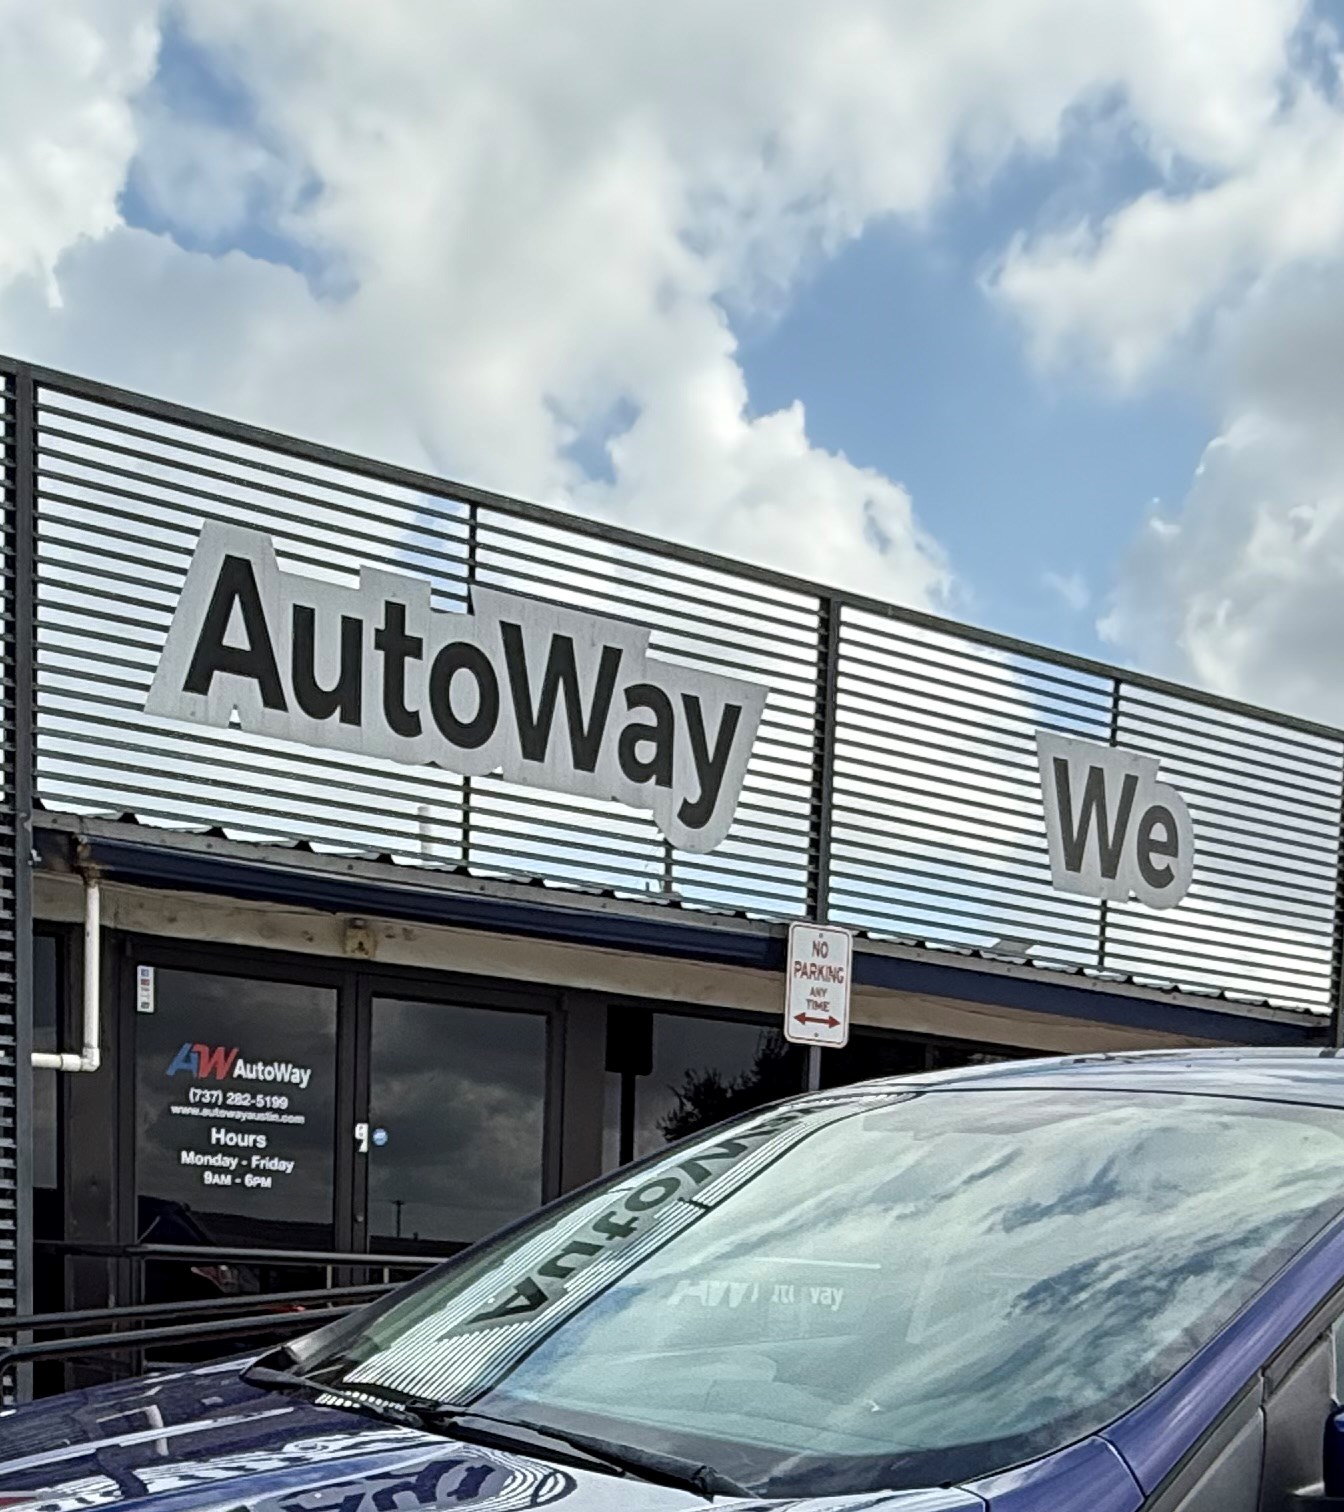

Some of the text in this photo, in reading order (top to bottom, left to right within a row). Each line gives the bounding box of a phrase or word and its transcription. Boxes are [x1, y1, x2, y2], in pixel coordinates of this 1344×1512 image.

[182, 553, 743, 829] AutoWay
[1052, 756, 1179, 888] We
[812, 940, 829, 959] NO
[793, 961, 844, 984] PARKING
[809, 987, 828, 998] ANY
[806, 999, 830, 1012] TIME
[166, 1043, 311, 1088] AW AutoWay
[189, 1087, 288, 1109] (737) 282-5199
[170, 1105, 305, 1124] www.autowayaustin.com
[211, 1127, 267, 1148] Hours
[181, 1151, 238, 1170] Monday
[251, 1155, 294, 1173] Friday
[204, 1171, 232, 1185] 9AM
[244, 1174, 272, 1188] 6PM
